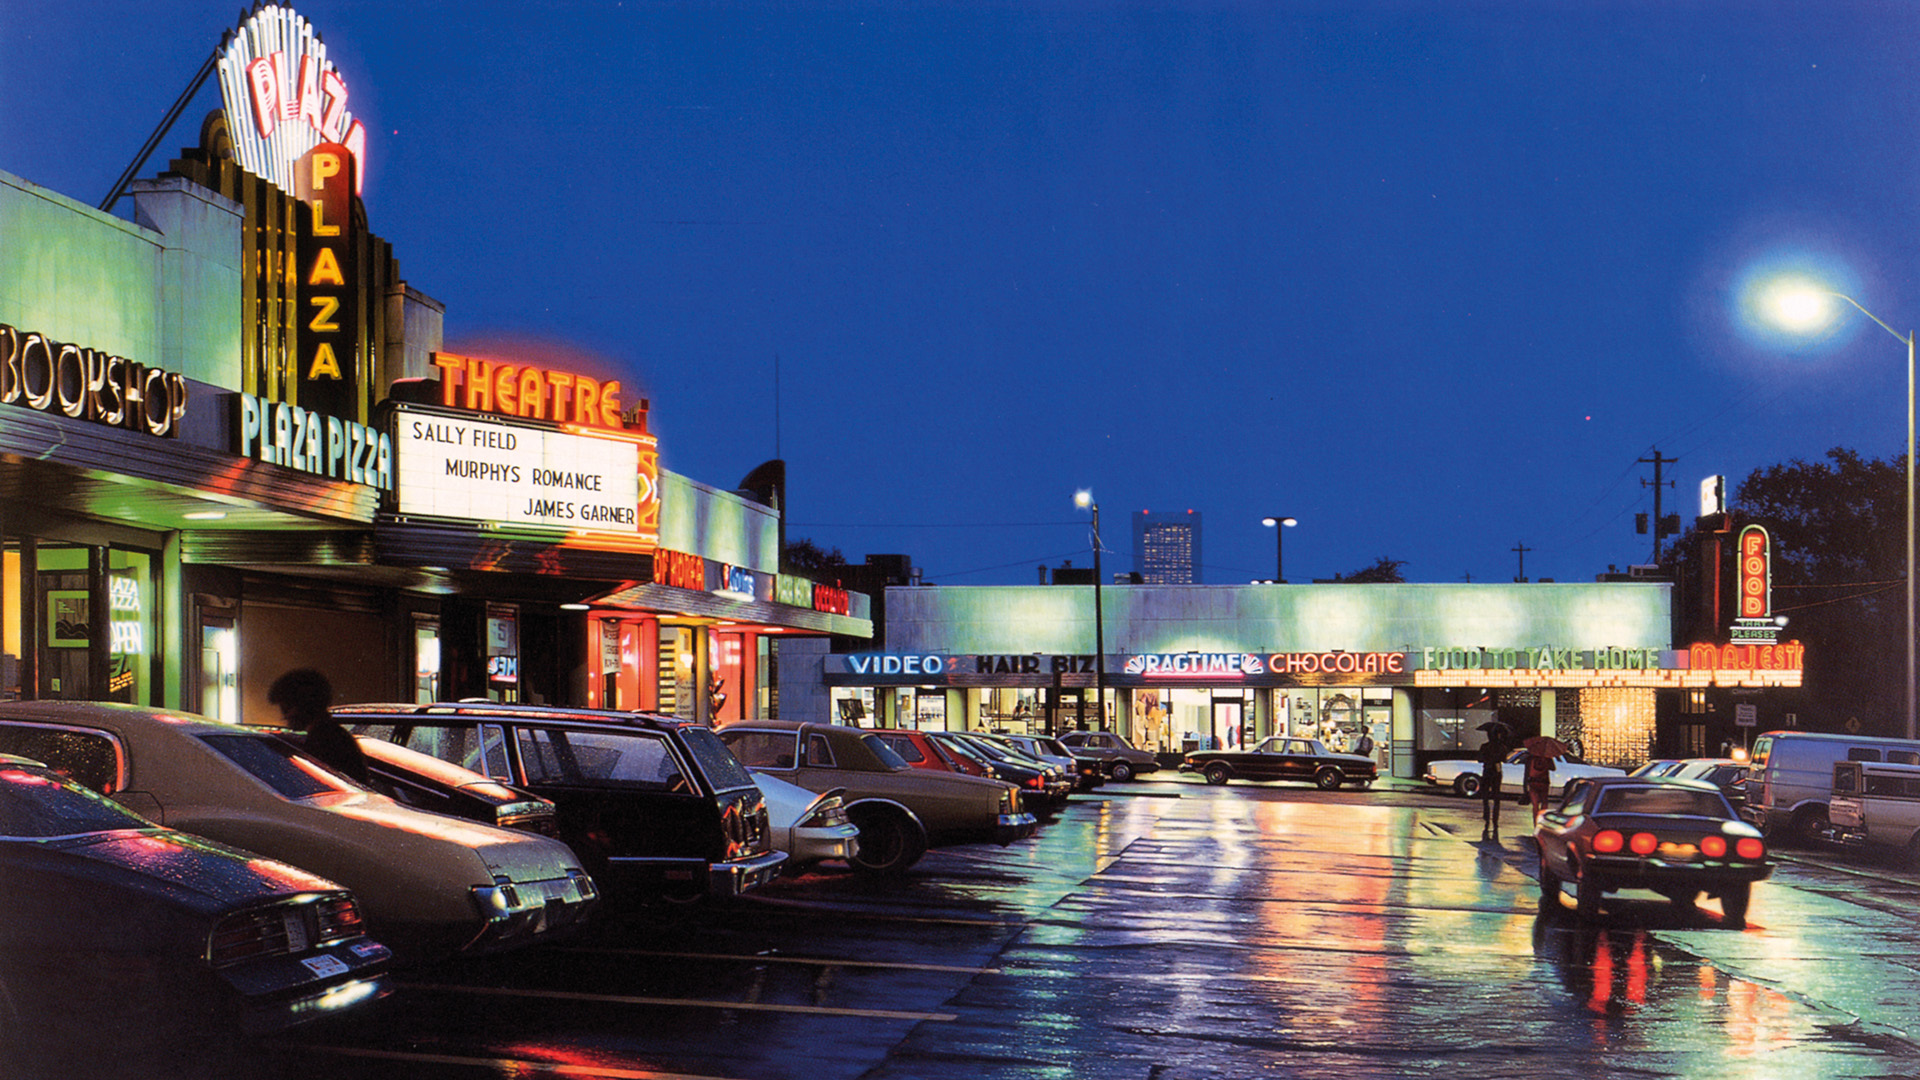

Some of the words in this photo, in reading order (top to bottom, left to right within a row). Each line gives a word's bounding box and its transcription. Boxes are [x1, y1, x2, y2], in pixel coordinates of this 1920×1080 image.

[308, 152, 344, 381] PLAZA
[0, 322, 190, 440] BOOKSHOP
[430, 351, 623, 429] THEATRE
[241, 391, 323, 475] PLAZA
[327, 414, 393, 491] PIZZA
[412, 421, 467, 446] SALLY
[473, 429, 517, 451] FIELD
[445, 458, 521, 483] MURPHYS
[532, 468, 603, 492] ROMANCE
[524, 498, 575, 519] JAMES
[580, 504, 635, 525] GARNER
[109, 575, 140, 597] LAZA
[1744, 535, 1764, 616] FOOD
[109, 593, 141, 611] IZZA
[1731, 629, 1776, 639] PLEASES
[848, 655, 943, 674] VIDEO
[975, 654, 1041, 674] HAIR
[1051, 654, 1098, 674] BIZ
[1145, 653, 1242, 674] RAGTIME
[1268, 652, 1404, 674] CHOCOLATE
[1423, 646, 1482, 670] FOOD
[1491, 648, 1517, 670] TO
[1523, 647, 1584, 670] TAKE
[1593, 646, 1659, 670] HOME
